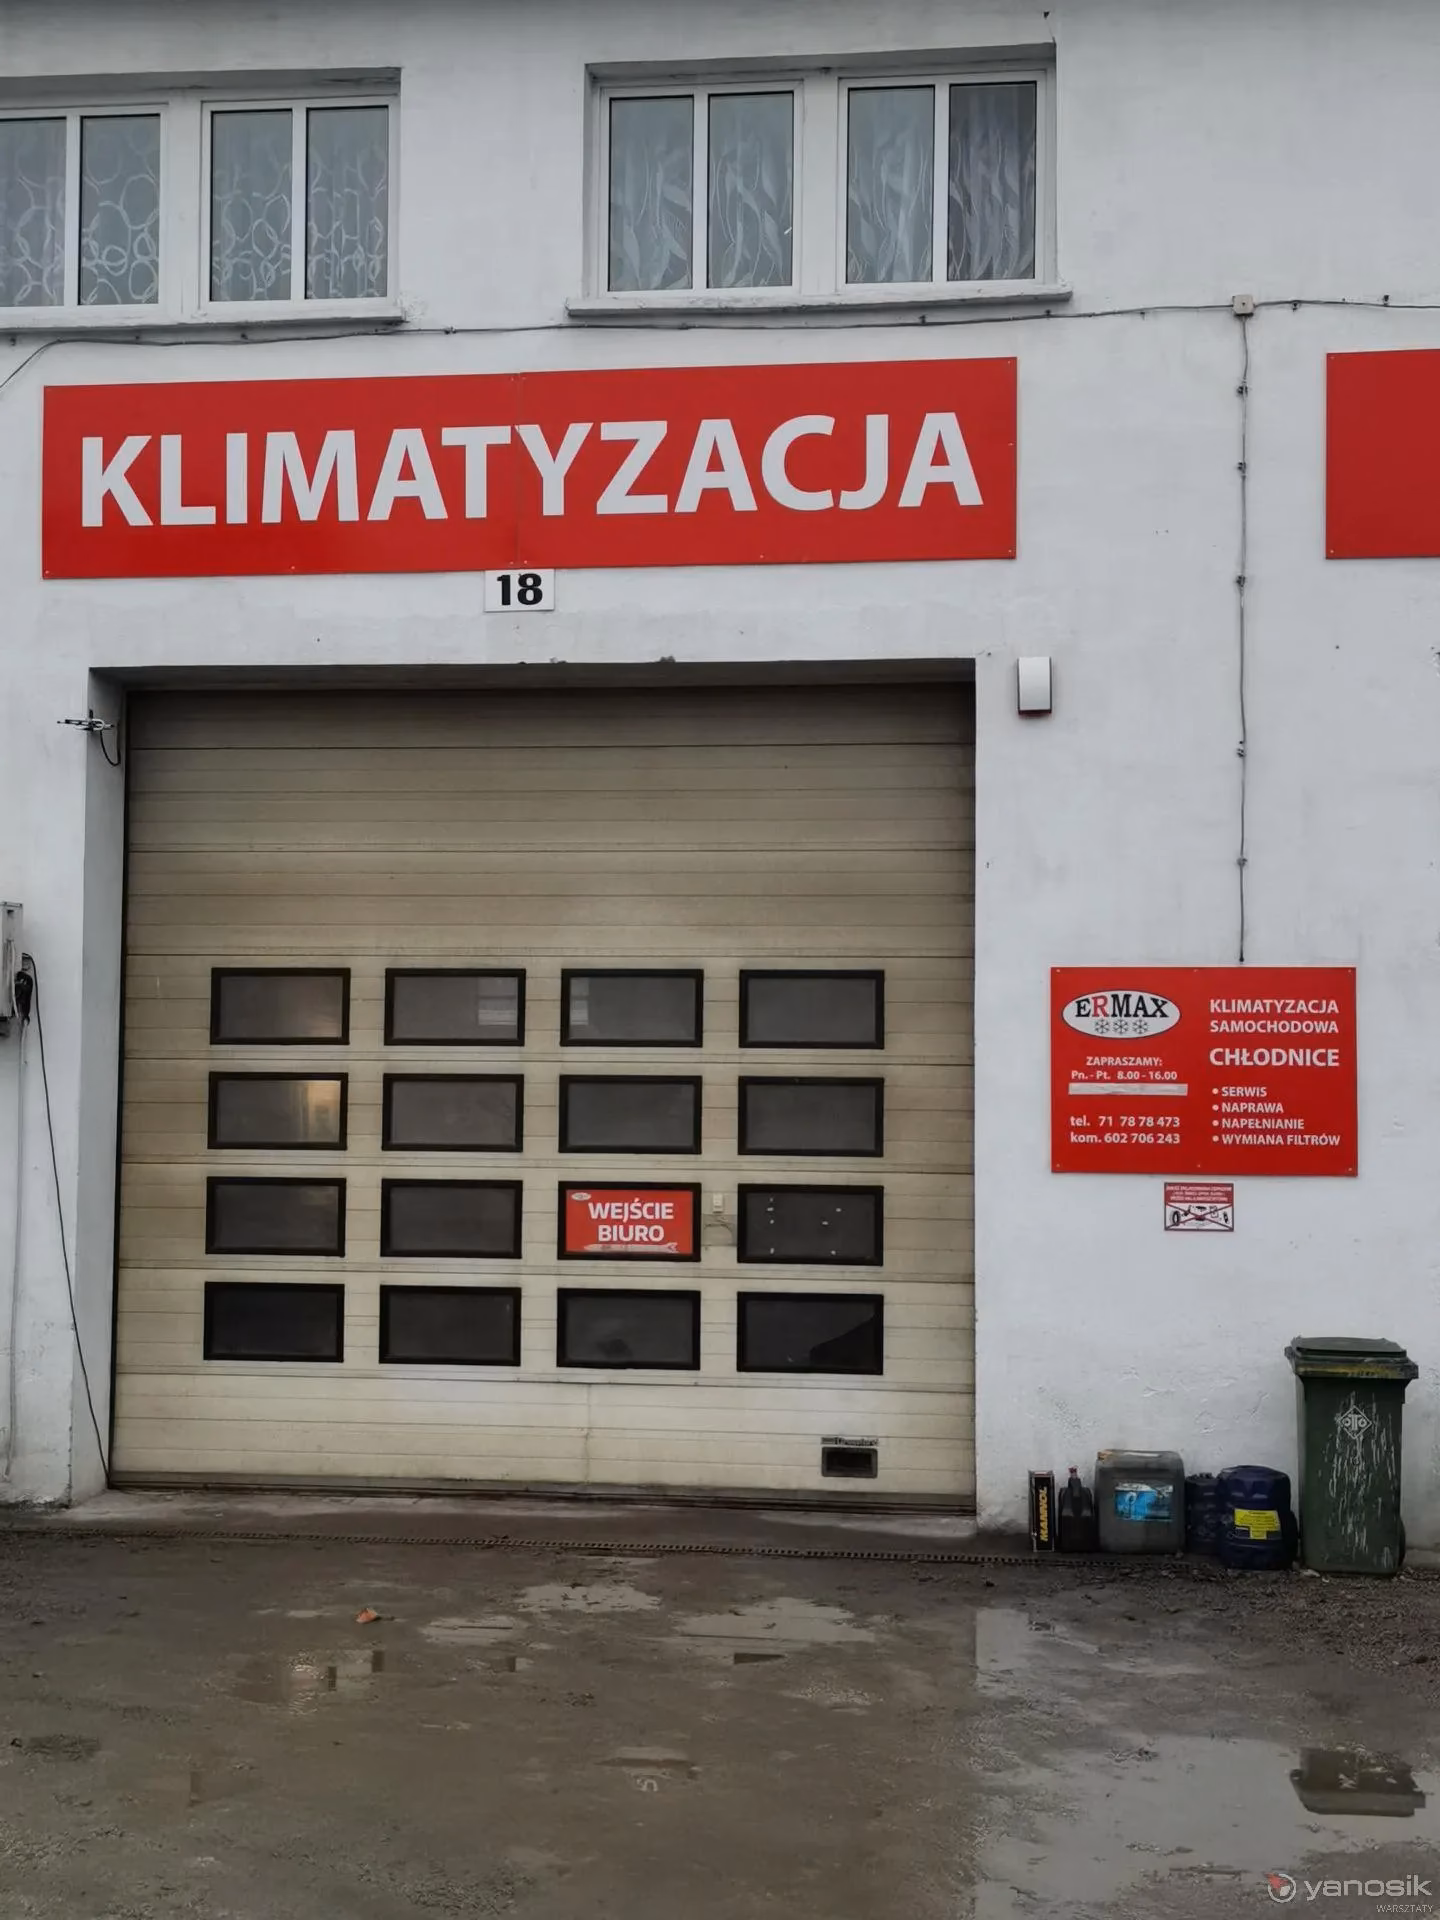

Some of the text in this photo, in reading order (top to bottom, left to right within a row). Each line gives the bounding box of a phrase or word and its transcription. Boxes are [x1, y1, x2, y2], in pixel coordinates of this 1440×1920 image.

[81, 411, 984, 528] KLIMATYZACJA
[496, 573, 544, 606] 18
[1075, 993, 1170, 1018] ERMAX
[1209, 999, 1339, 1014] KLIMATYZACJA
[1209, 1020, 1339, 1034] SAMOCHODOWA
[1086, 1056, 1163, 1066] ZAPRASZAMY:
[1209, 1047, 1340, 1067] CHŁODNICE
[1117, 1071, 1140, 1080] 8.00
[1149, 1071, 1178, 1080] 16.00
[1221, 1086, 1267, 1097] SERWIS
[1221, 1102, 1284, 1113] NAPRAWA
[1070, 1115, 1180, 1128] tel. 71 78 78 473
[1221, 1118, 1305, 1130] NAPEŁNIANIE
[1070, 1132, 1180, 1145] kom. 602 706 243
[1222, 1133, 1341, 1146] WYMIANA FILTRÓW
[588, 1197, 675, 1223] WEJŚCIE
[598, 1224, 665, 1243] BIURO
